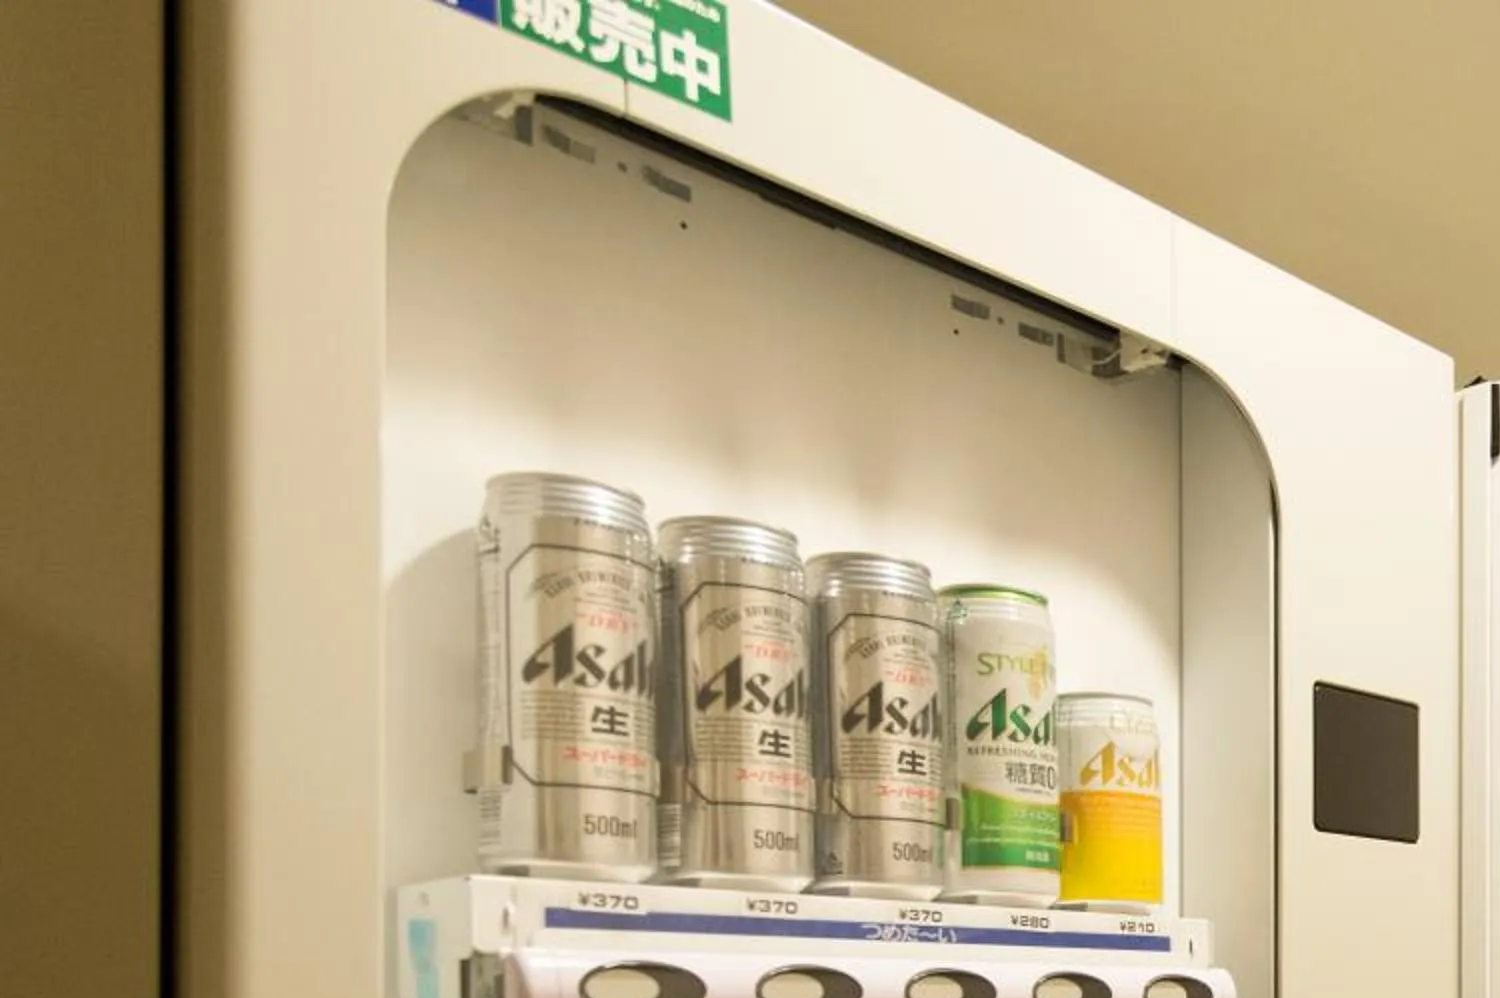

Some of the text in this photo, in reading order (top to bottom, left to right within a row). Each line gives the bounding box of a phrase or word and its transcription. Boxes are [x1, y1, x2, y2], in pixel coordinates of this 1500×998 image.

[522, 622, 656, 699] Asah
[695, 653, 808, 720] Asah
[591, 705, 630, 737] 生
[841, 680, 942, 740] Asah
[965, 688, 1057, 747] Asa
[759, 729, 792, 758] 生
[898, 750, 927, 776] 生
[1080, 740, 1159, 792] Asa
[584, 814, 638, 838] 500ml
[753, 829, 800, 851] 500ml
[577, 891, 640, 911] ¥370
[745, 898, 799, 916] ¥370
[899, 908, 943, 924] ¥370
